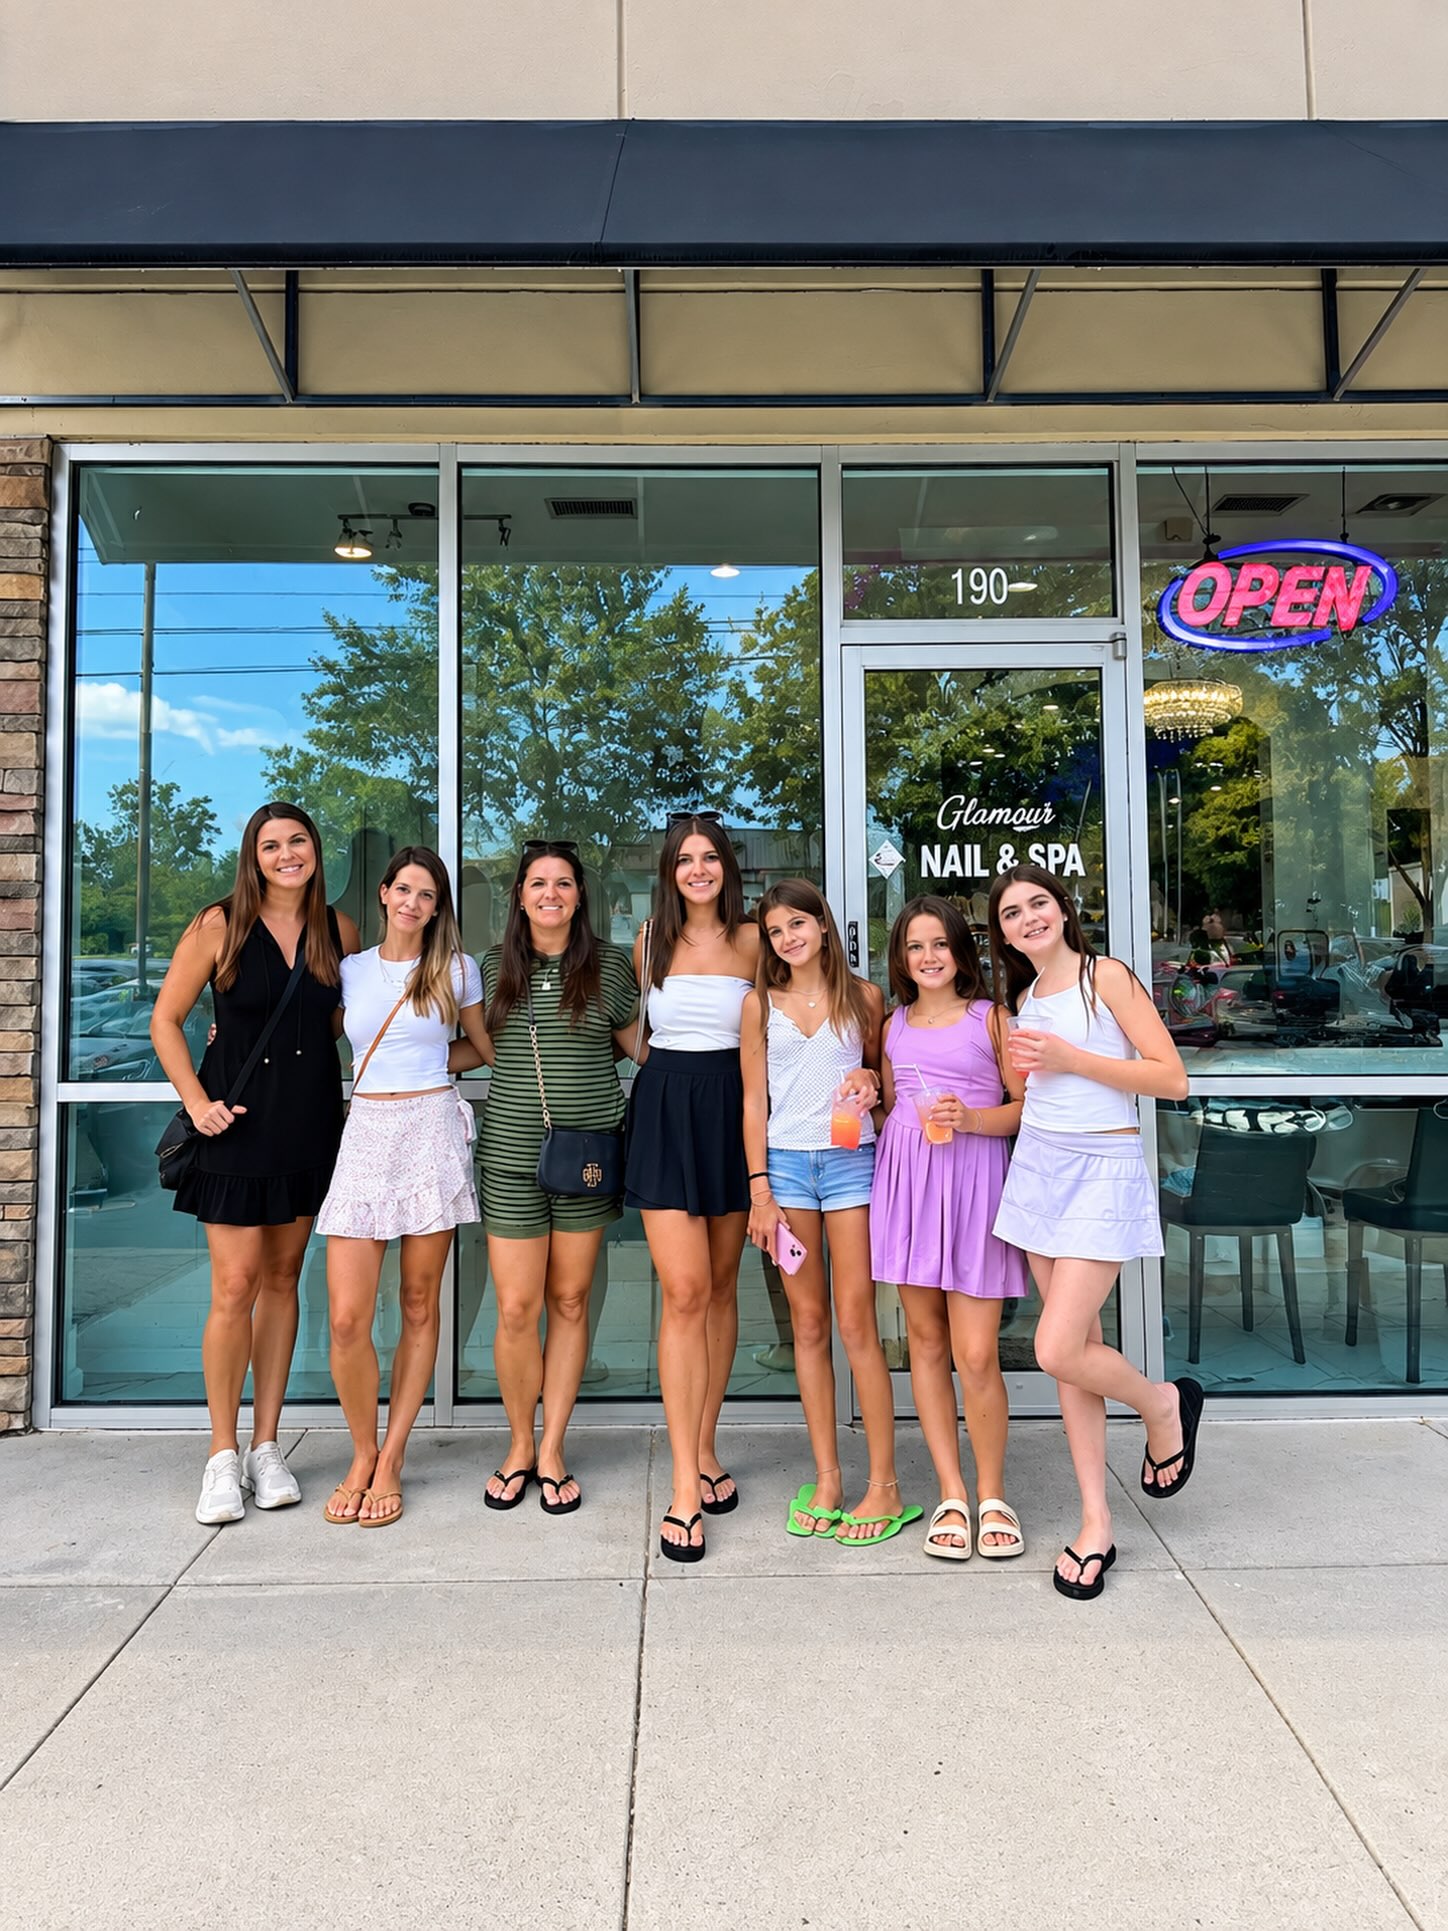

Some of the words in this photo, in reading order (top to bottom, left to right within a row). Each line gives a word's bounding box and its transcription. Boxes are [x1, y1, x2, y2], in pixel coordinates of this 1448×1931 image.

[952, 567, 1009, 605] 190
[1177, 561, 1372, 631] OPEN
[936, 794, 1056, 832] Glamour
[920, 843, 990, 878] NAIL
[996, 843, 1019, 876] &
[1028, 842, 1087, 877] SPA
